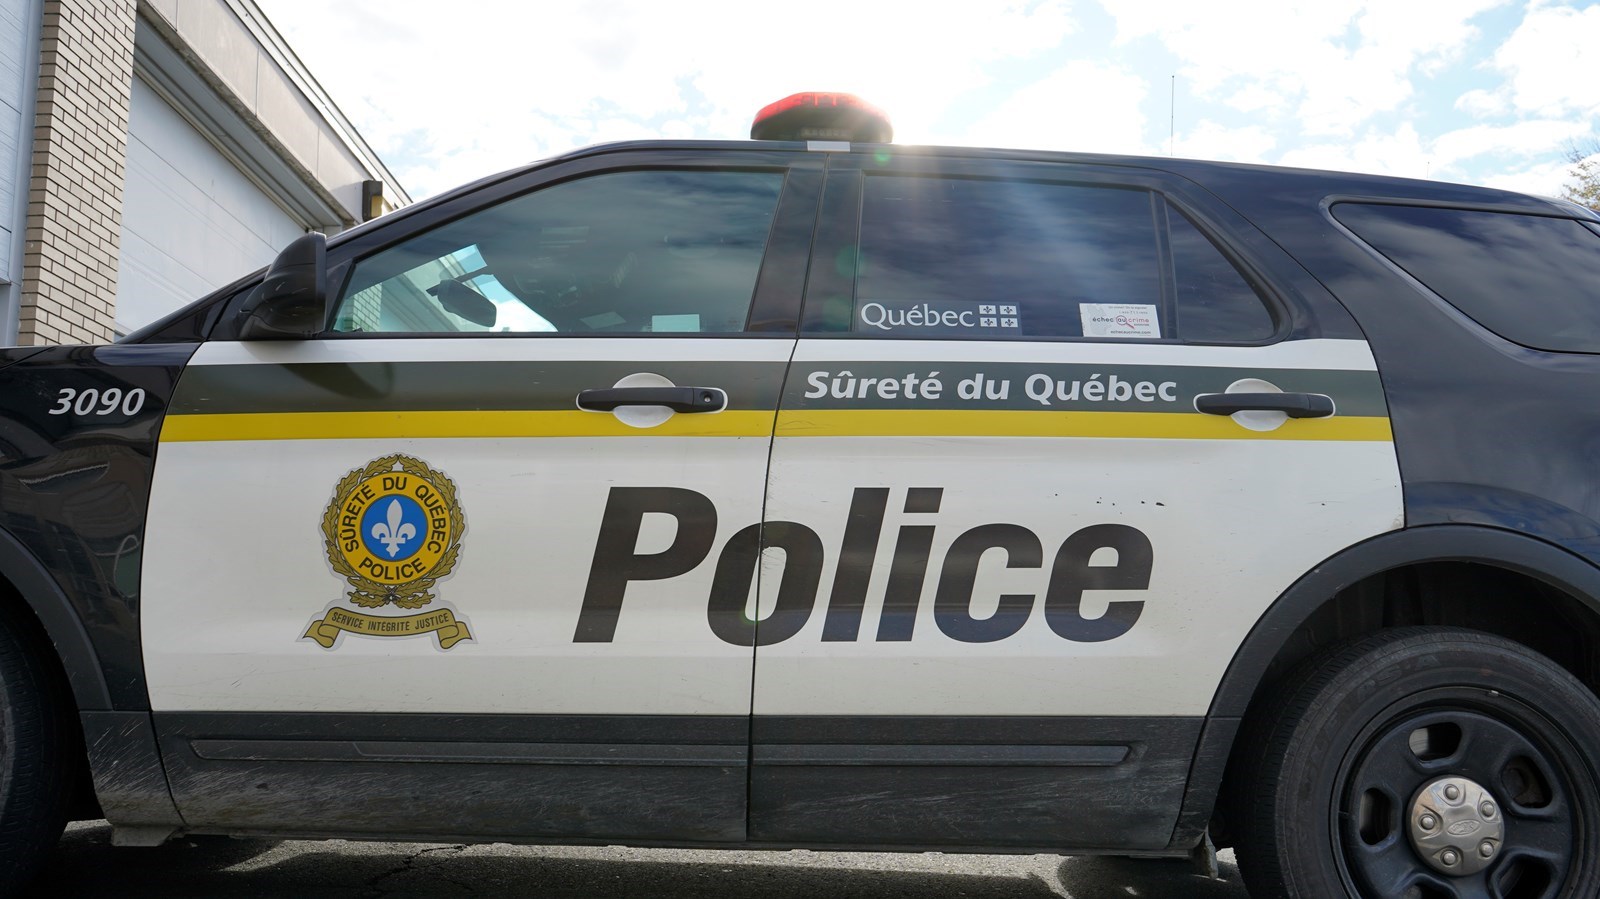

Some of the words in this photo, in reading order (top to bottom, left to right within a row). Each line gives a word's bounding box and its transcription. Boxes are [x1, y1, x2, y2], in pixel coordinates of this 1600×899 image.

[861, 302, 975, 330] Québec
[48, 387, 146, 416] 3090
[804, 371, 943, 399] Sûreté
[957, 373, 1010, 400] du
[1024, 373, 1177, 406] Québec
[340, 484, 376, 553] SÛRETÉ
[382, 476, 408, 491] DU
[415, 484, 447, 554] QUÉBEC
[358, 556, 426, 580] POLICE
[572, 486, 1154, 647] Police
[331, 611, 364, 629] SERVICE
[414, 612, 449, 629] JUSTICE
